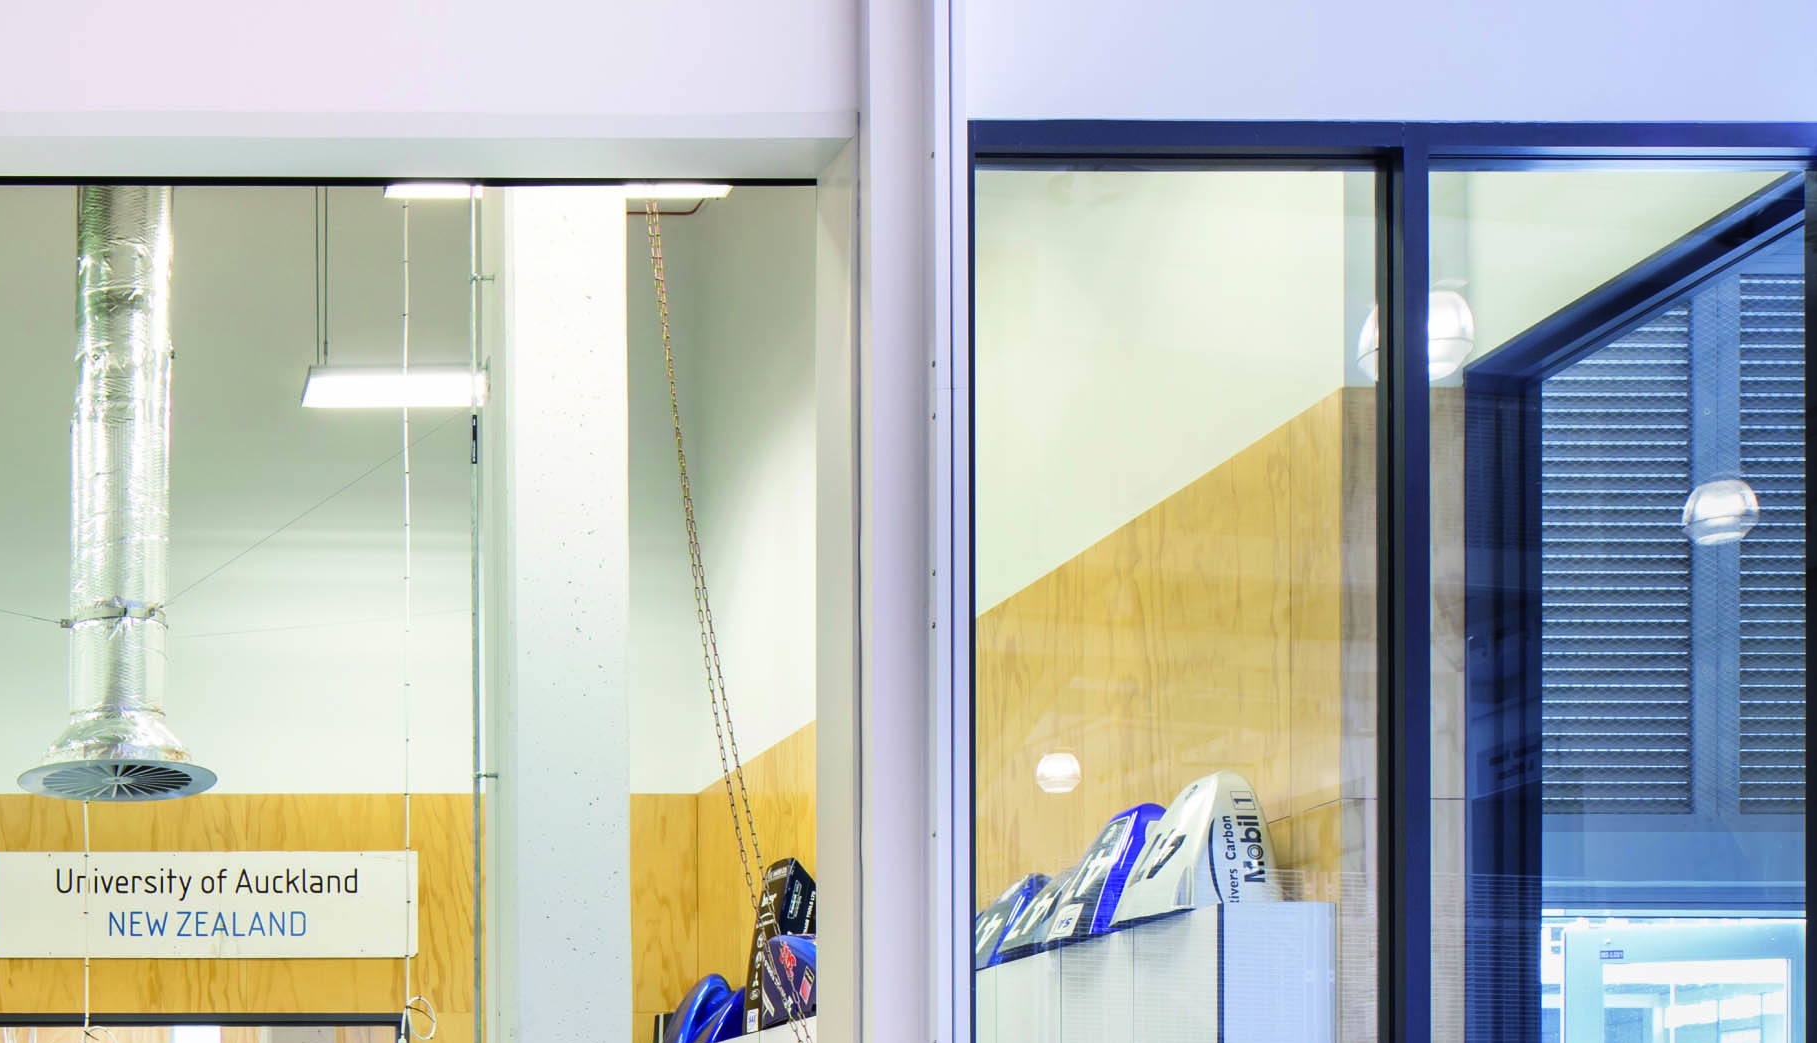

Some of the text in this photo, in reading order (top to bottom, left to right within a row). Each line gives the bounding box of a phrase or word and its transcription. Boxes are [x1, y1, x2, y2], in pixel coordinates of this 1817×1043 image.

[1221, 815, 1233, 861] Carbon
[1236, 815, 1266, 884] Mobil
[54, 867, 359, 902] University of Auckland
[108, 911, 307, 938] NEW ZEALAND
